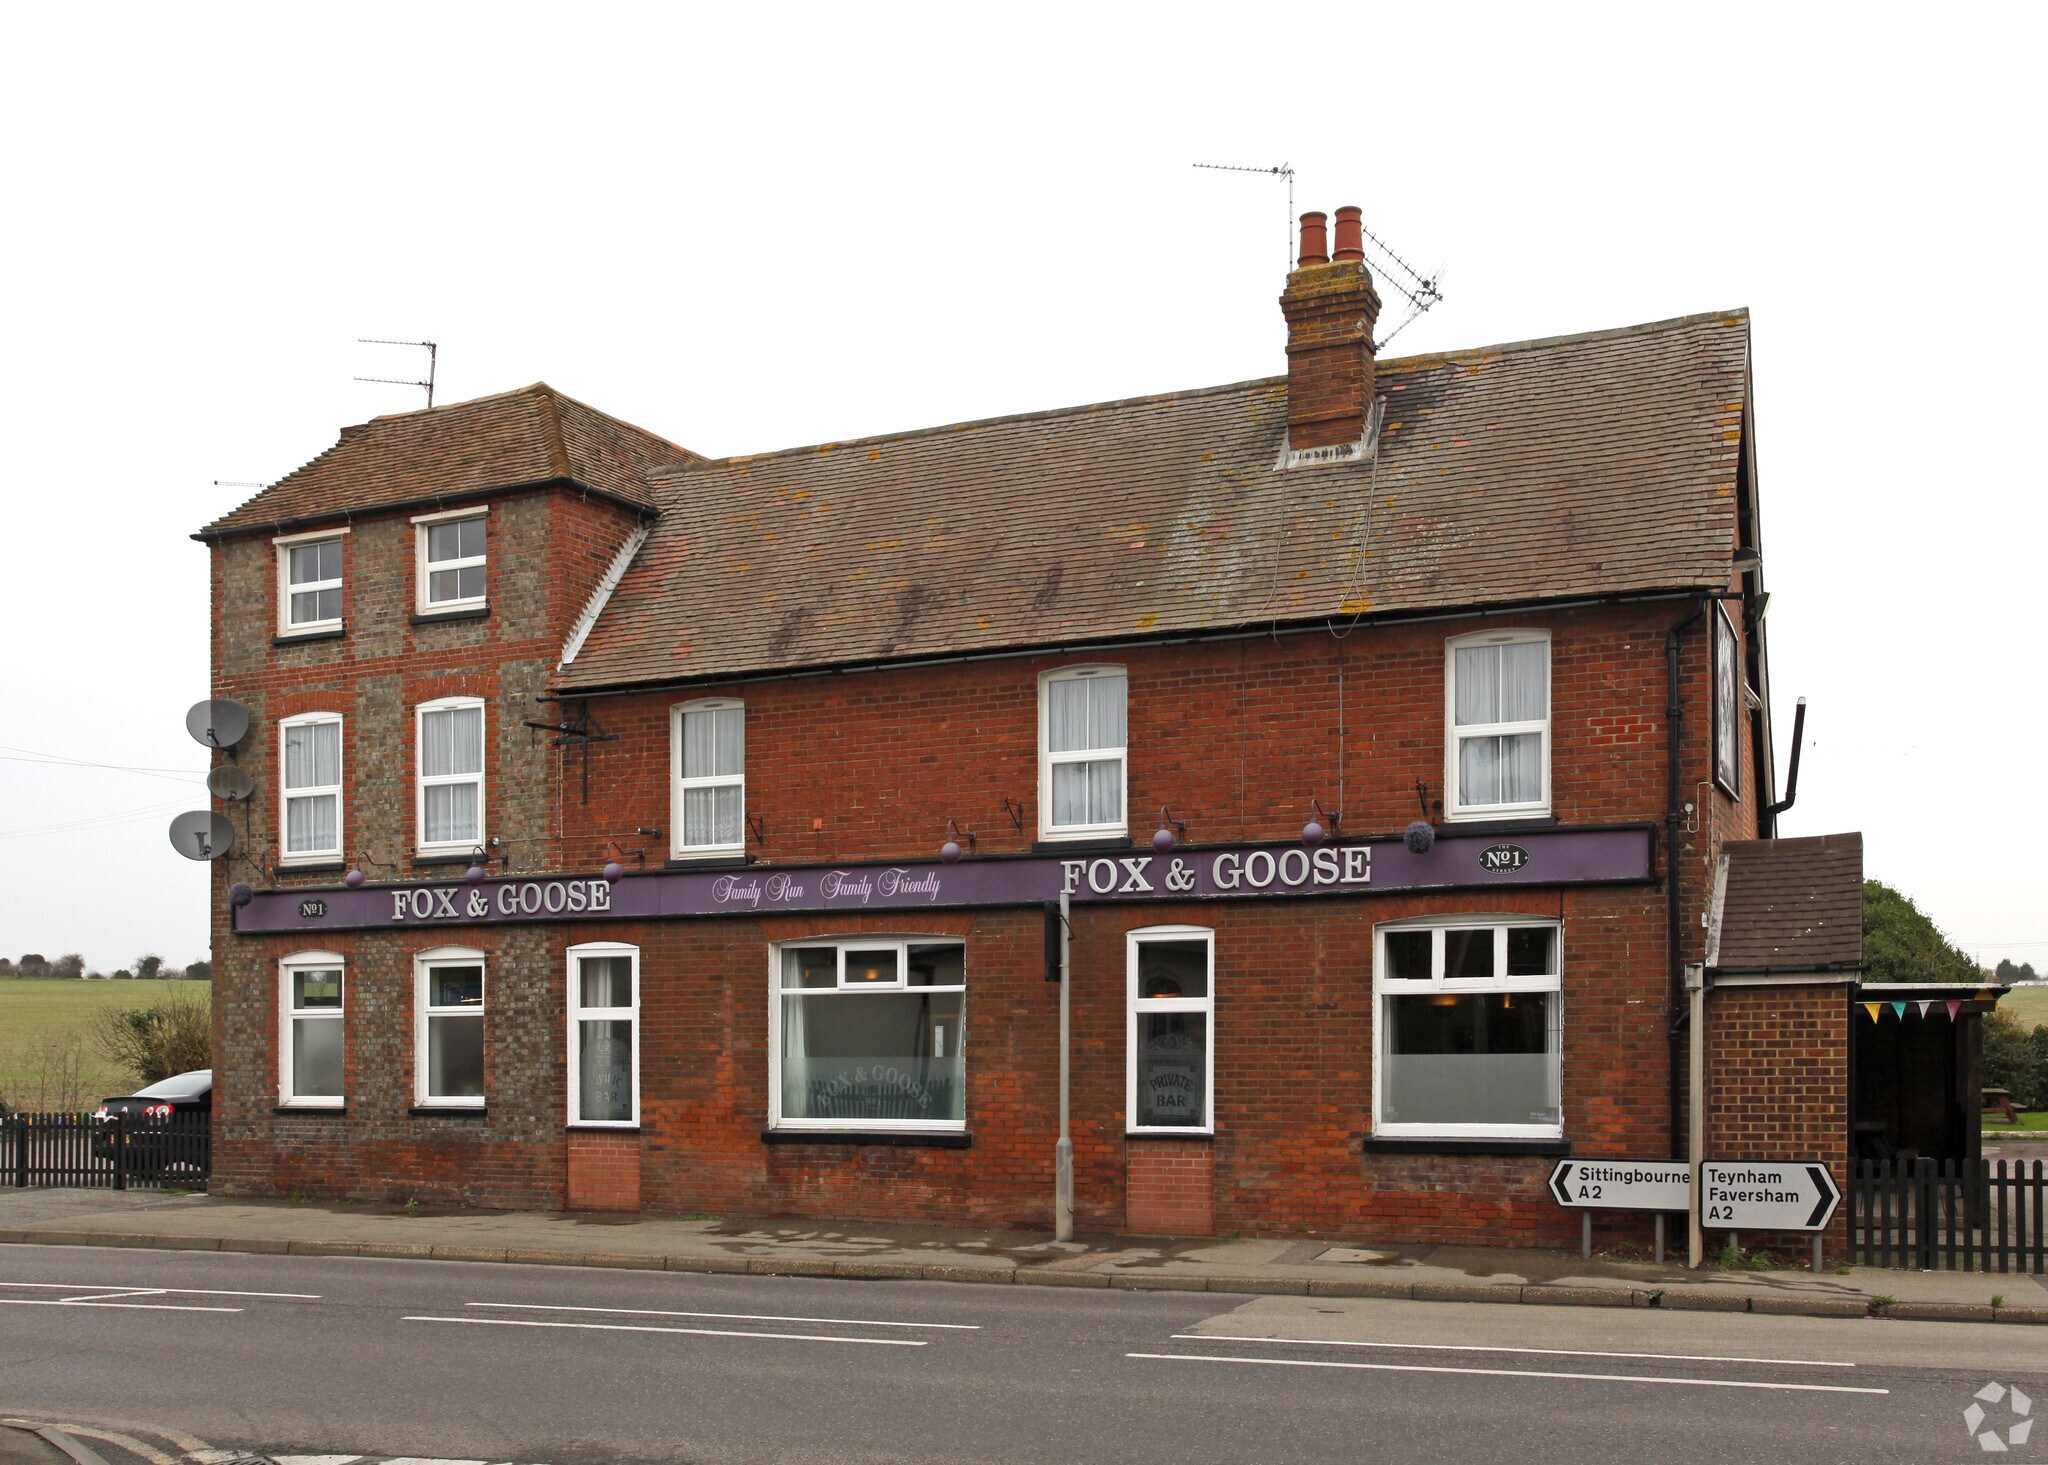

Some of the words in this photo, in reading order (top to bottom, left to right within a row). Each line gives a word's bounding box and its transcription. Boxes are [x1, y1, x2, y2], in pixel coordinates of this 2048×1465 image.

[1060, 857, 1154, 894] FOX
[1165, 858, 1195, 891] &
[1212, 846, 1372, 890] GOOSE
[712, 874, 761, 907] Family
[765, 872, 804, 902] Run
[820, 870, 873, 903] Family
[877, 867, 941, 901] Friendly
[391, 888, 459, 920] FOX
[466, 889, 489, 918] &
[497, 880, 611, 915] GOOSE
[817, 1072, 852, 1108] FOX
[855, 1066, 868, 1082] &
[871, 1064, 932, 1109] GOOSE
[1150, 1073, 1194, 1092] PRIVATE
[595, 1091, 618, 1102] BAR
[1157, 1094, 1186, 1107] BAR
[1579, 1167, 1690, 1184] Sittingbourne
[1709, 1169, 1782, 1184] Teynham
[1709, 1187, 1799, 1203] Faversham
